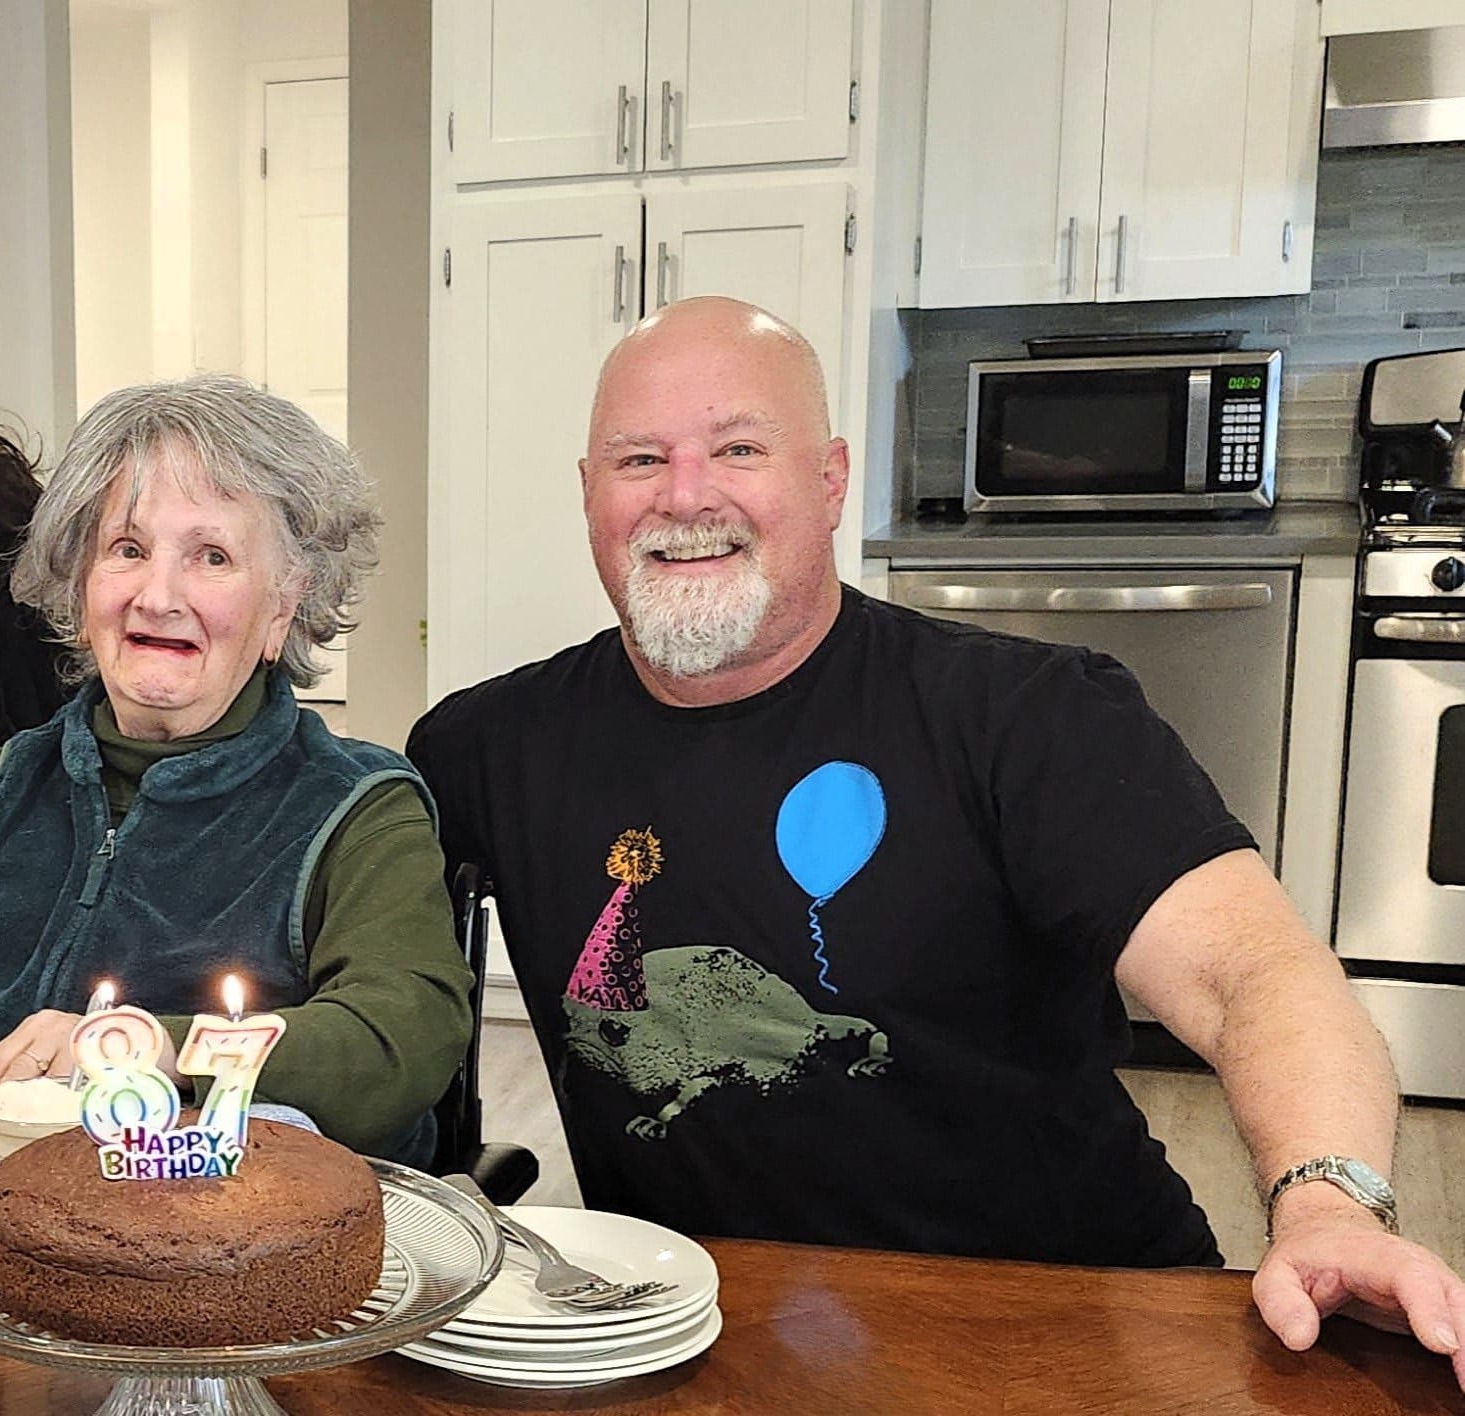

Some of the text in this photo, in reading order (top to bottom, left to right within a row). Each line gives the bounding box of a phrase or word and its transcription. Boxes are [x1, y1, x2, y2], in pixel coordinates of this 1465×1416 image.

[577, 979, 630, 1010] YAY!
[121, 1126, 224, 1156] HAPPY
[102, 1151, 240, 1179] BIRTHDAY
